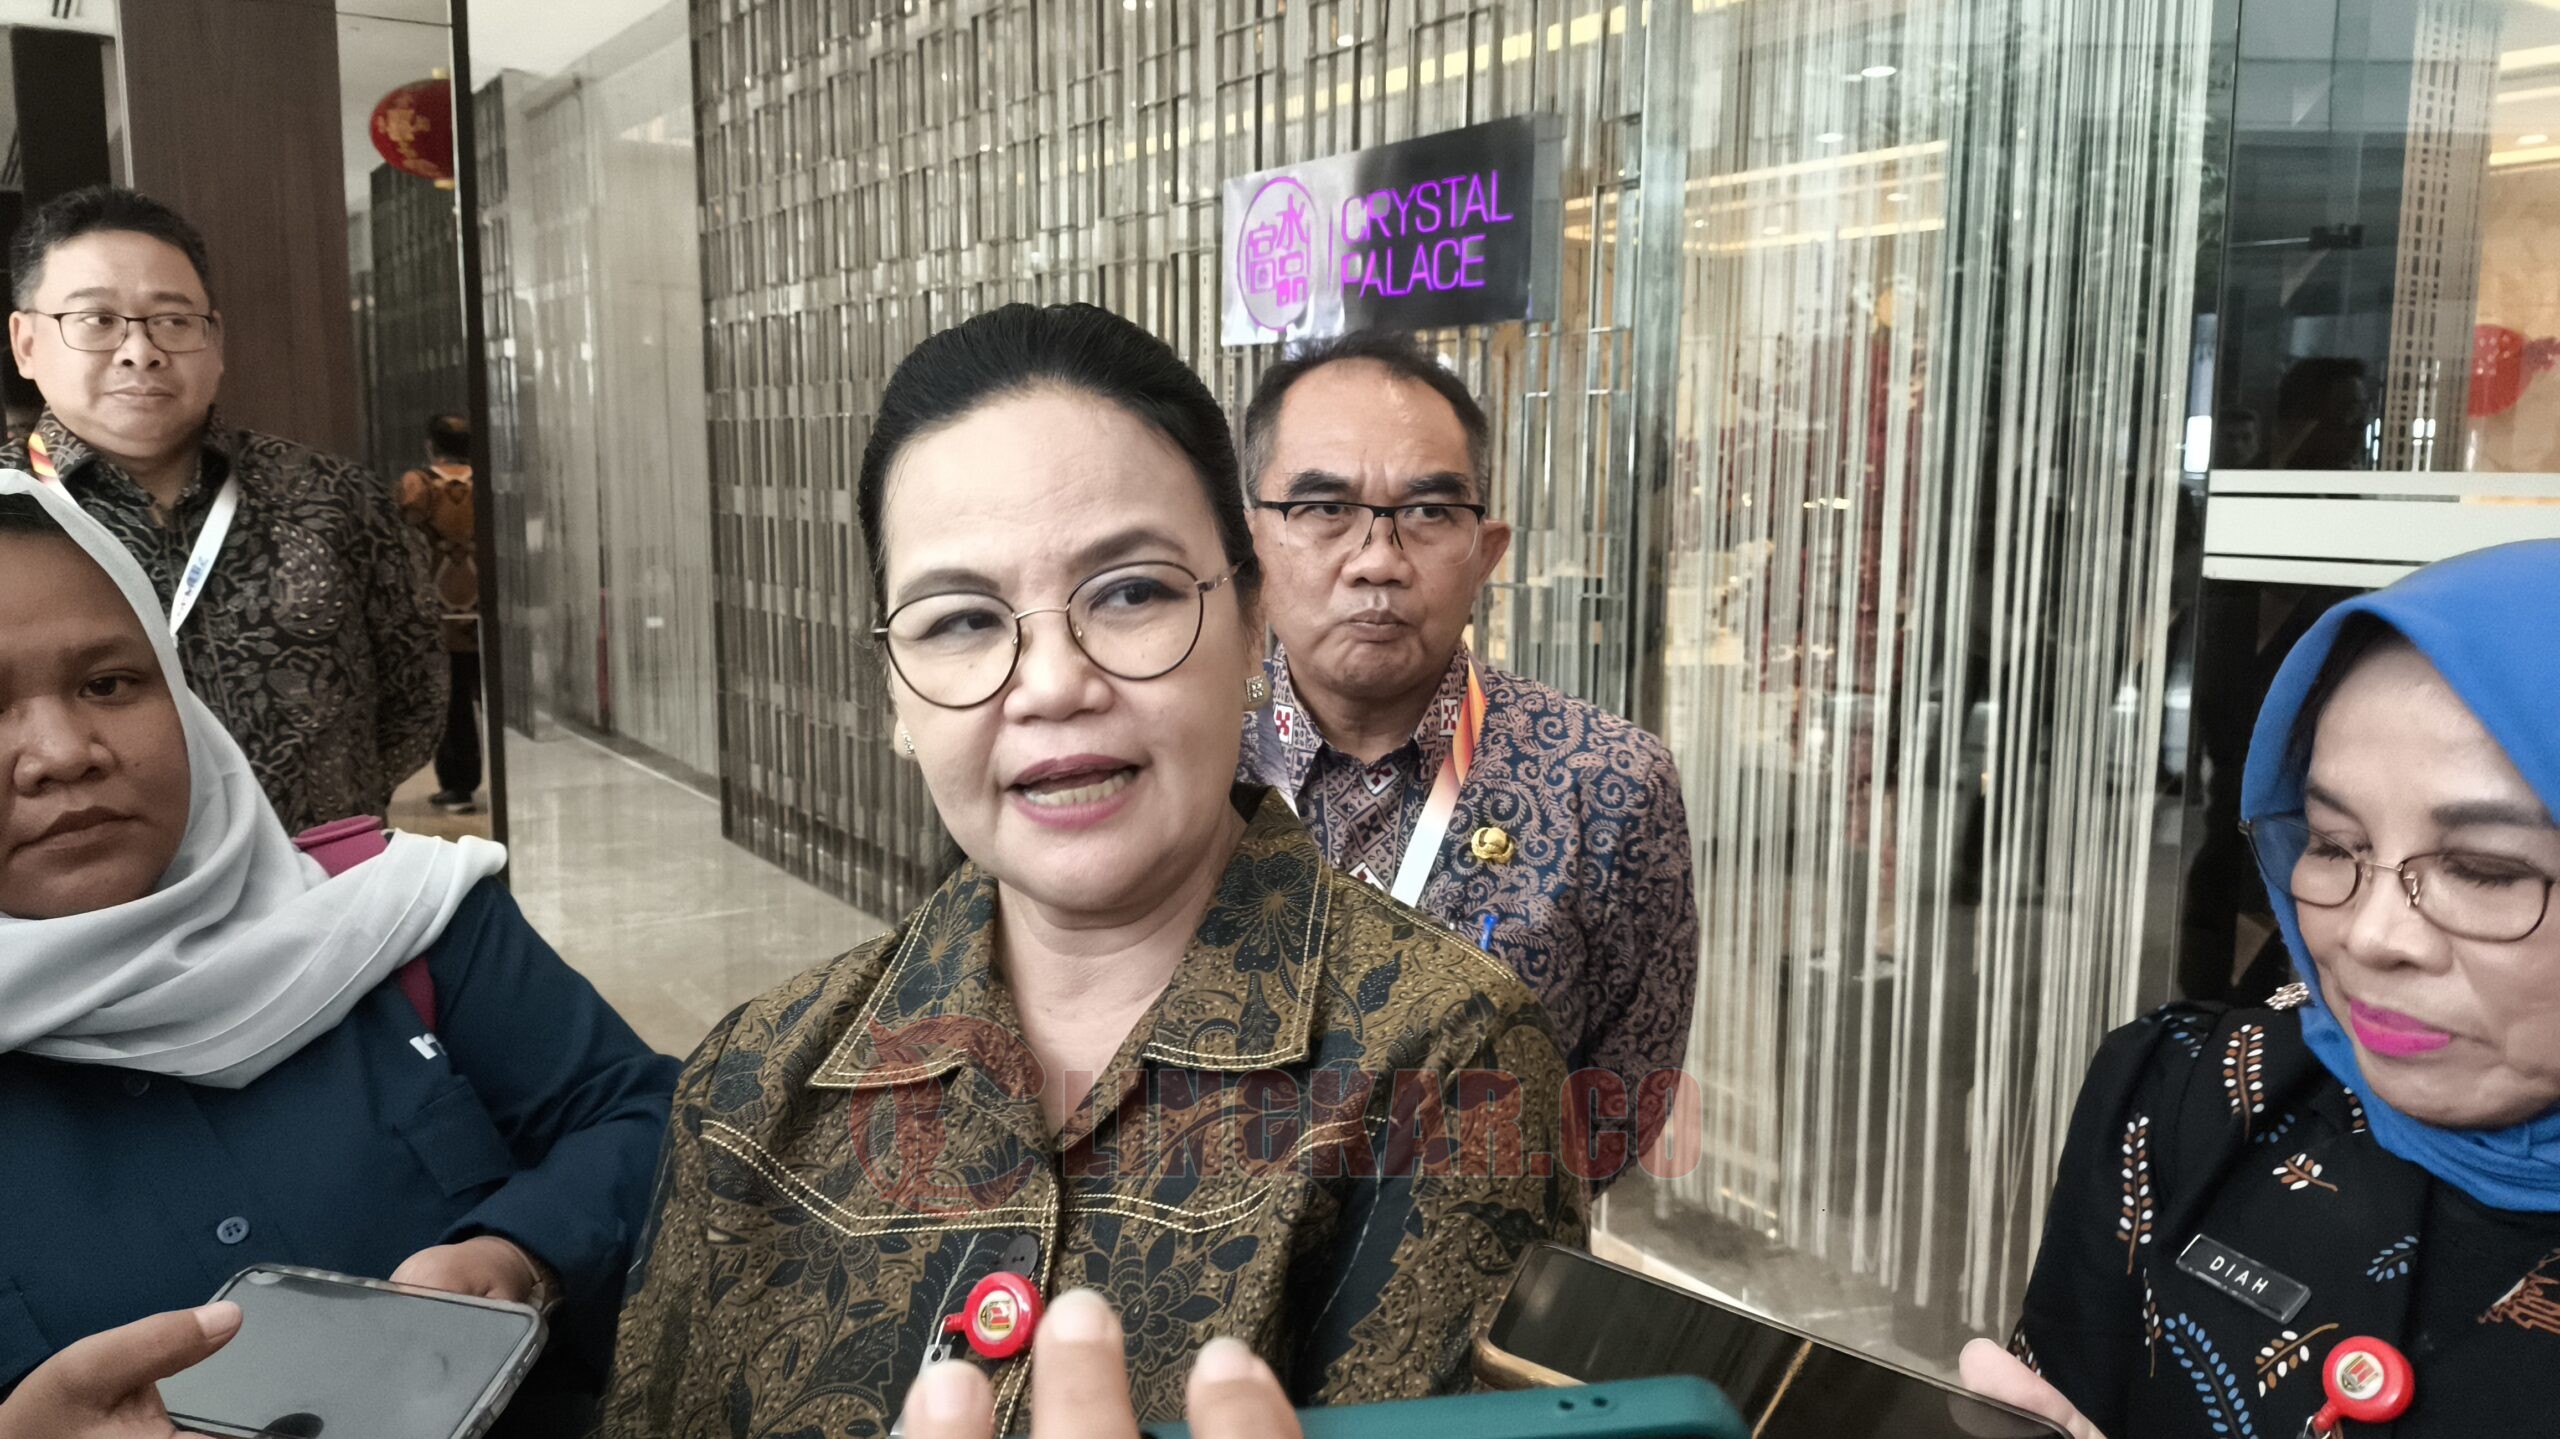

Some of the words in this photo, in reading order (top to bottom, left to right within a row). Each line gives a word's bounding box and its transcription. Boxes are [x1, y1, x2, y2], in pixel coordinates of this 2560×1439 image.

[1341, 169, 1514, 245] CRYSTAL
[1340, 233, 1487, 300] PALACE
[2208, 1255, 2270, 1295] DIAH
